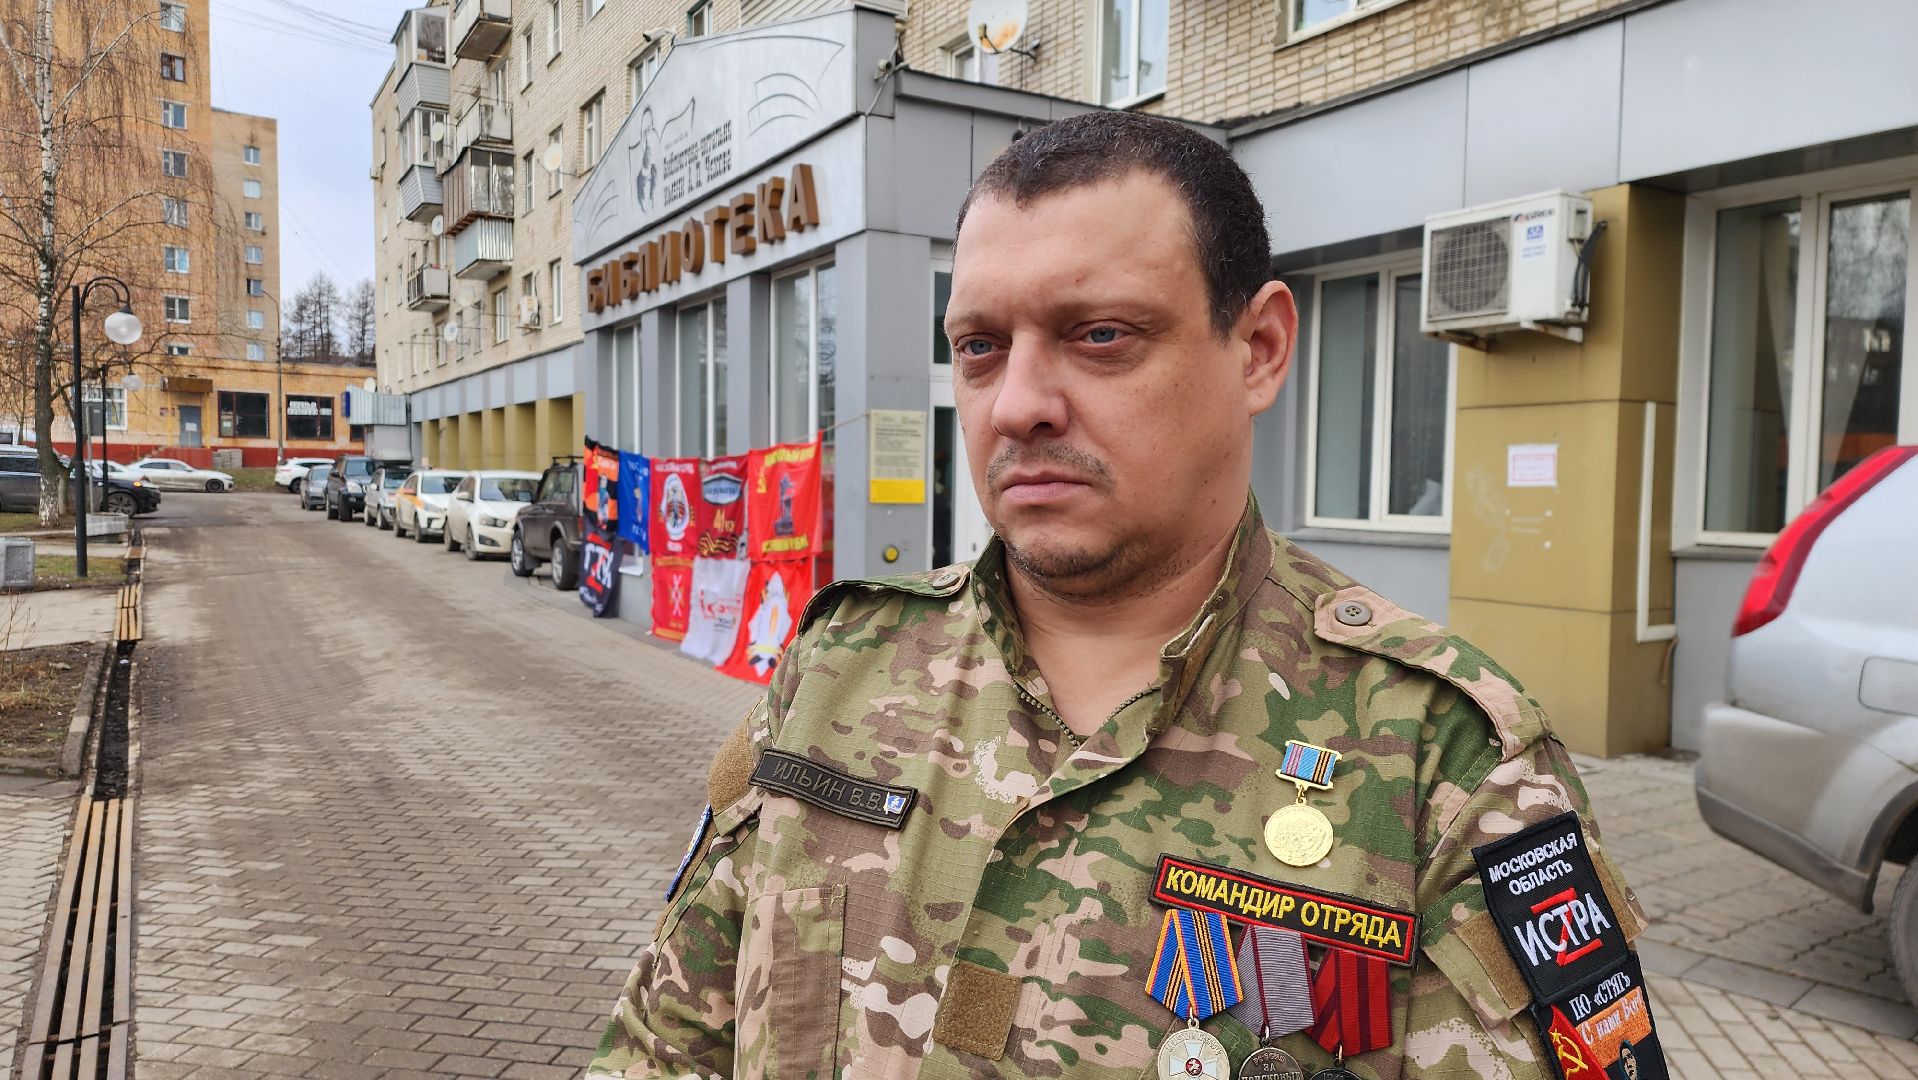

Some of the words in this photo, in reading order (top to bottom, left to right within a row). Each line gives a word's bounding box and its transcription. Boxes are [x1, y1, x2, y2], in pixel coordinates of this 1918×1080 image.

[587, 163, 820, 313] БИБЛИОТЕКА
[771, 761, 848, 802] ИЛЬИН
[1488, 832, 1578, 884] МОСКОВСКАЯ
[1508, 859, 1574, 896] ОБЛАСТЬ
[1165, 866, 1296, 919] КОМАНДИР
[1300, 901, 1402, 948] ОТРЯДА
[1513, 892, 1611, 967] ИСТРА
[1568, 993, 1591, 1021] ПО
[1580, 1021, 1594, 1046] С
[1263, 1062, 1277, 1072] ЗА
